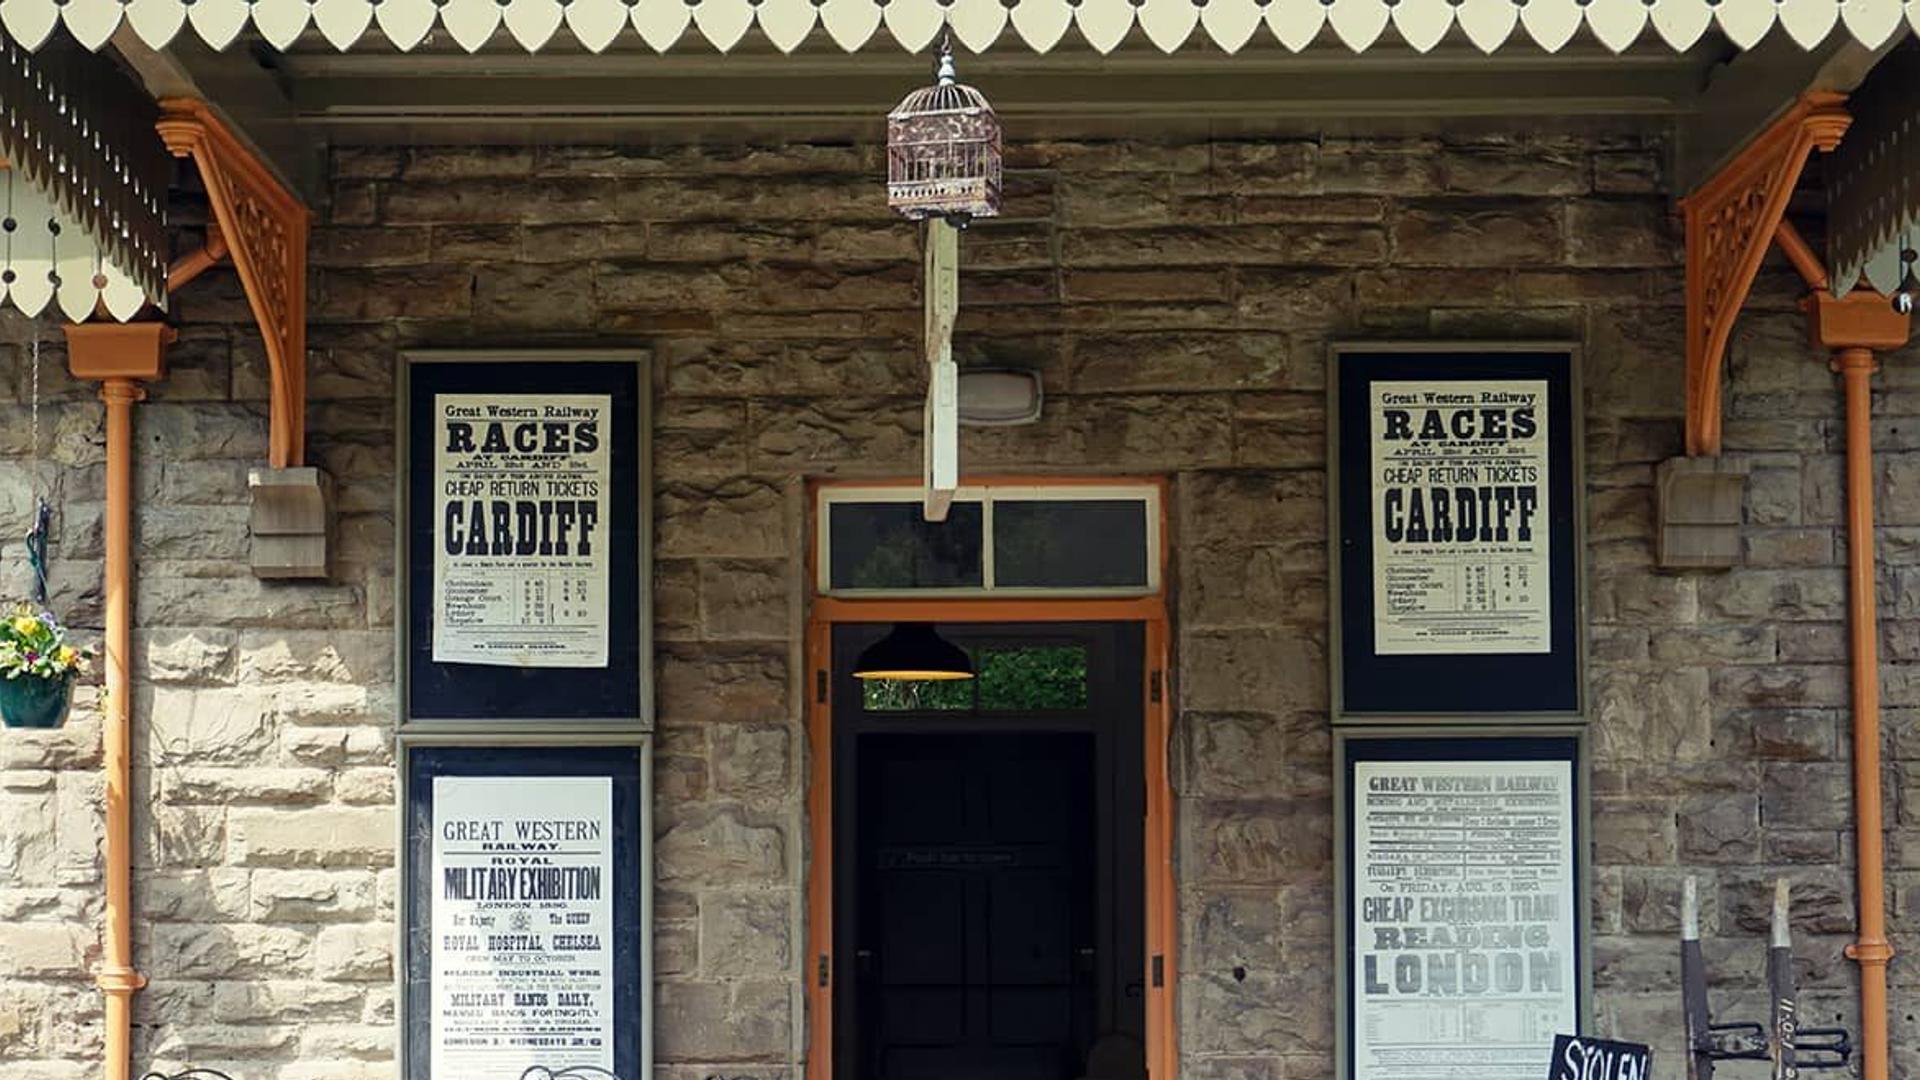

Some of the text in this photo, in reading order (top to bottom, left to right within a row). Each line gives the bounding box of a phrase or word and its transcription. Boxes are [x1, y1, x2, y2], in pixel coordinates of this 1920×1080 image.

[1383, 392, 1535, 405] Great Western Railway
[446, 406, 598, 420] Great Western Railway
[1384, 409, 1536, 440] RACES
[446, 423, 598, 453] RACES
[1384, 467, 1537, 483] CHEAP RETURN TICKETS
[446, 482, 598, 497] CHEAP RETURN TICKETS
[1385, 487, 1537, 542] CARDIFF
[445, 501, 598, 556] CARDIFF
[1369, 776, 1558, 790] GREAT WESTERN RAILWAY
[444, 821, 601, 840] GREAT WESTERN
[444, 867, 601, 900] MILITARY EXHIBITION
[1380, 884, 1395, 892] On
[1363, 897, 1413, 922] CHEAP
[1420, 896, 1507, 922] EXCURSION
[444, 936, 479, 951] ROYAL
[553, 935, 601, 950] CHELSEA
[1374, 926, 1549, 950] READING
[1364, 952, 1562, 994] LONDON
[451, 994, 504, 1006] MILITARY
[514, 993, 548, 1006] BANDS
